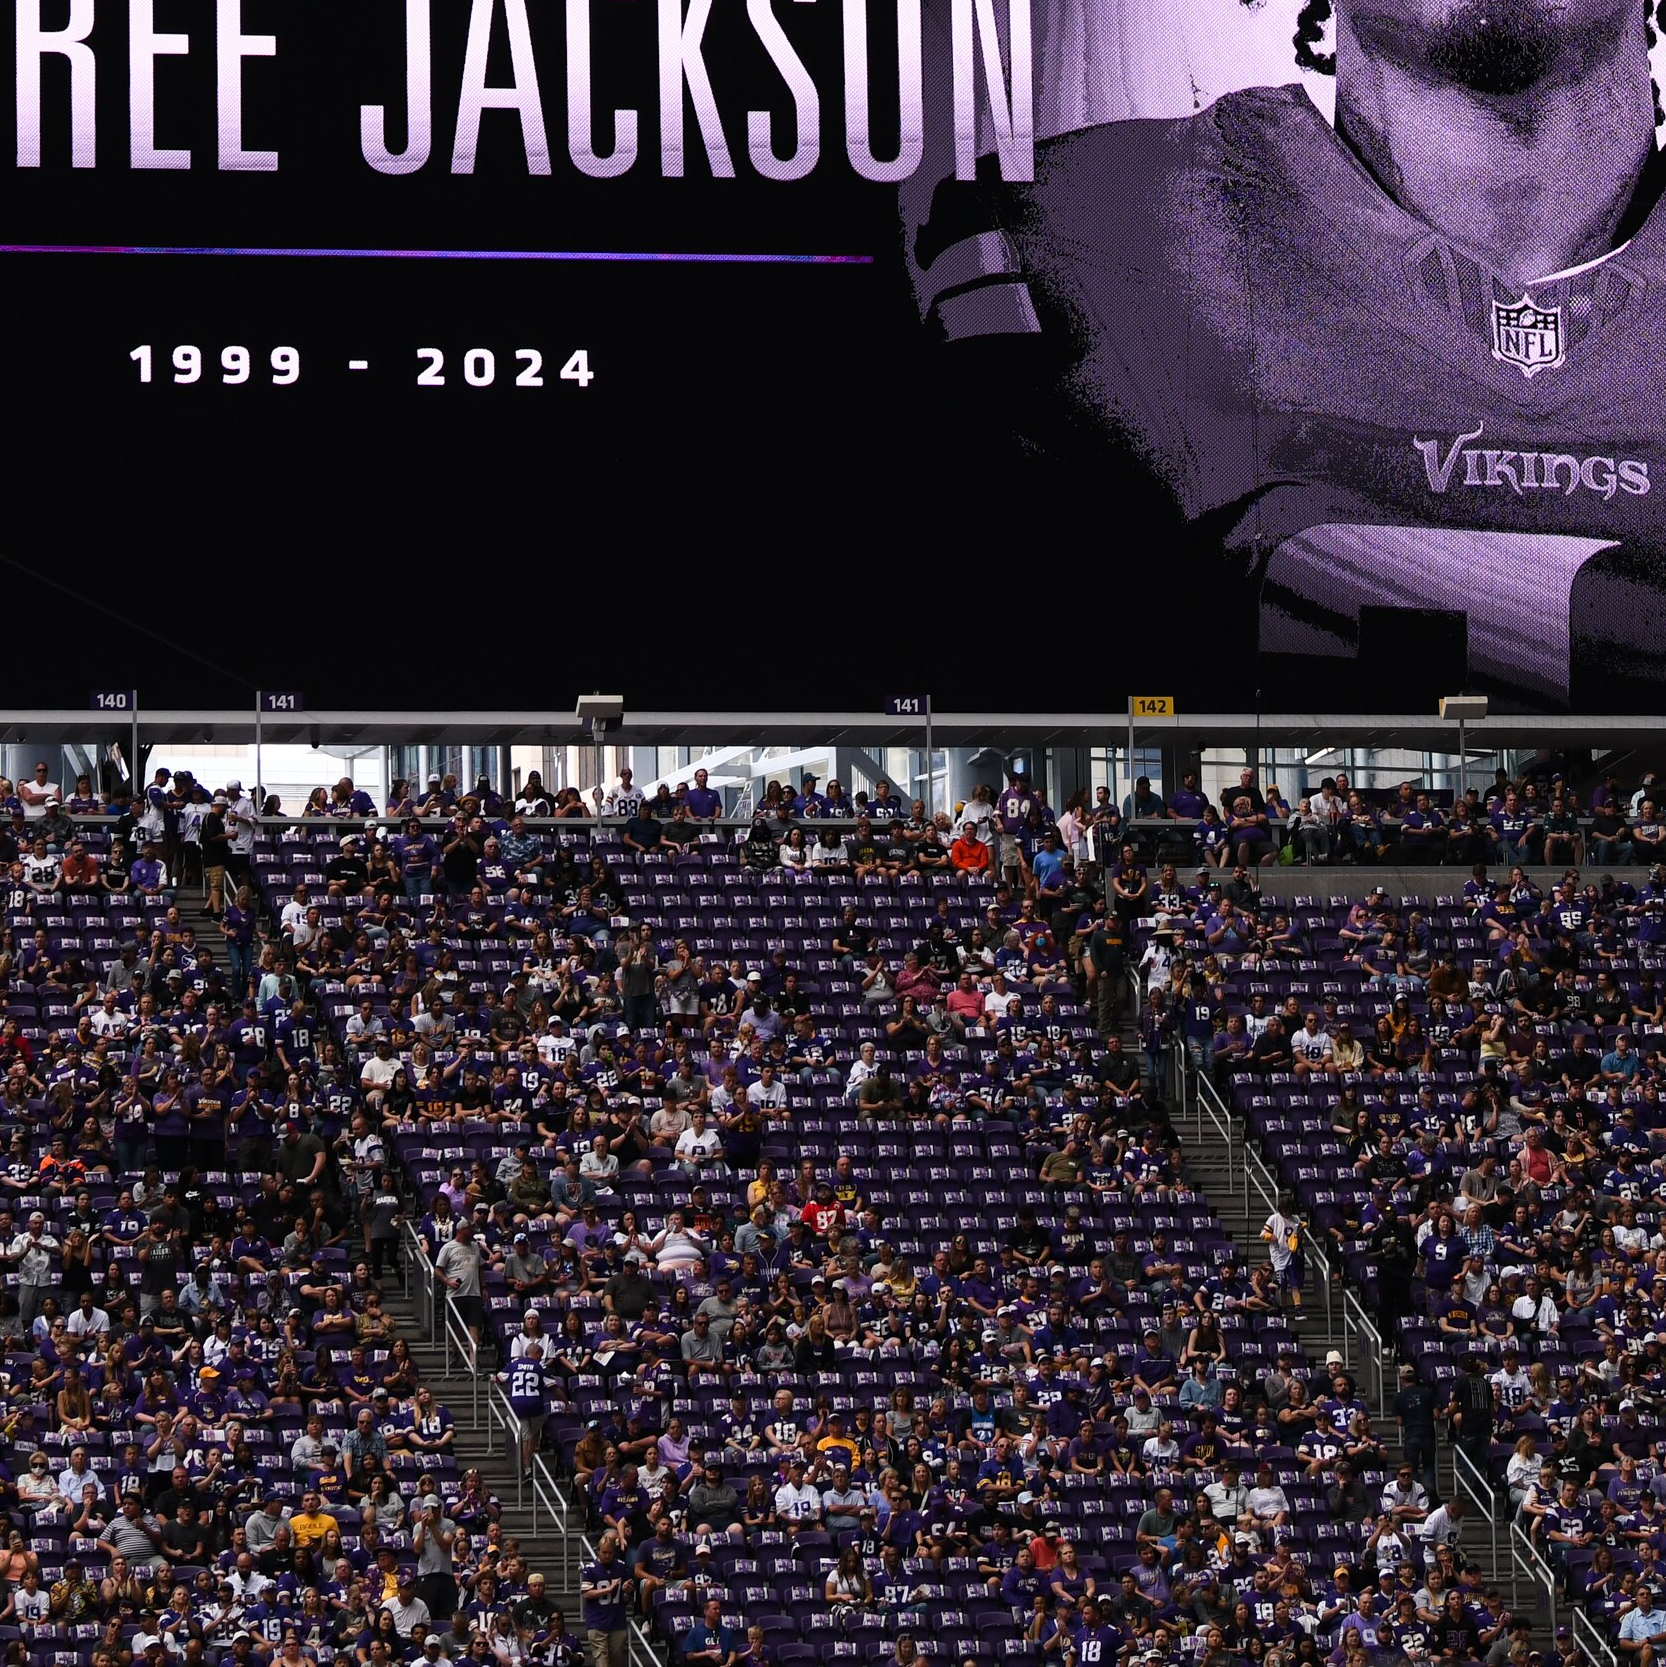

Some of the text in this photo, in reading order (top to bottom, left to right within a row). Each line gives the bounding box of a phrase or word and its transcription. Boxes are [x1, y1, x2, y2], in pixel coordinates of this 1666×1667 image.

[1502, 330, 1554, 360] NFL
[129, 343, 303, 386] 1999
[415, 346, 597, 388] 2024
[96, 693, 127, 708] 140
[268, 694, 295, 710] 141
[893, 698, 919, 713] 141
[1139, 699, 1167, 714] 142
[8, 890, 24, 907] 18
[1566, 995, 1580, 1007] 98
[1194, 1006, 1209, 1020] 19
[291, 1029, 309, 1048] 18
[1046, 1025, 1060, 1040] 18
[521, 1072, 538, 1089] 19
[816, 1211, 837, 1229] 87
[511, 1372, 539, 1396] 22
[420, 1417, 441, 1434] 18
[1558, 1457, 1579, 1473] 15
[1561, 1519, 1583, 1535] 52
[862, 1539, 874, 1553] 18
[261, 1619, 280, 1640] 19
[1402, 1634, 1424, 1651] 22
[1080, 1641, 1101, 1662] 18
